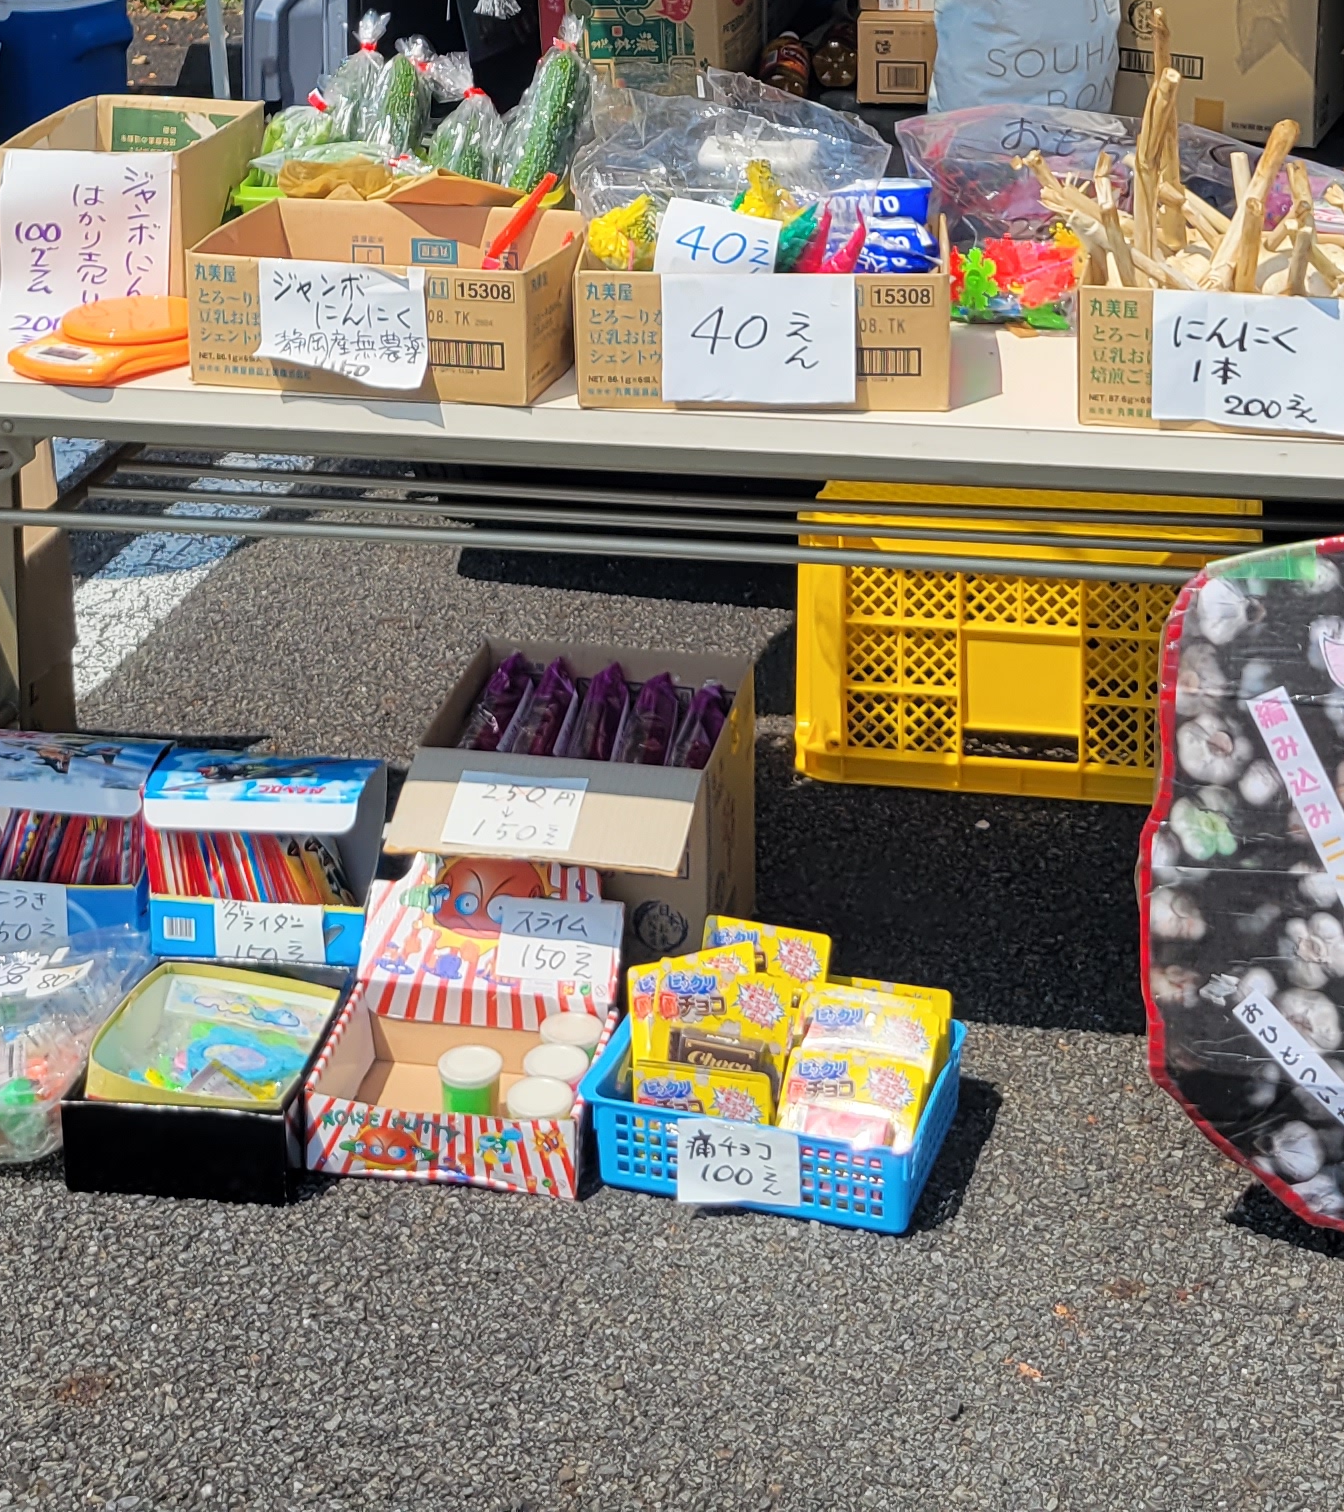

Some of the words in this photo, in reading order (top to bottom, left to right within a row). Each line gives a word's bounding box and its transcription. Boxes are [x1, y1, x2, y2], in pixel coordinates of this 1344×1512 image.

[14, 221, 62, 244] 100
[194, 262, 237, 284] 丸美屋
[197, 288, 260, 307] とろ〜り
[272, 269, 372, 305] ジャンボ
[456, 281, 512, 301] 15308
[585, 282, 634, 301] 丸美屋
[872, 287, 932, 305] 15308
[314, 302, 412, 330] にんにく
[1089, 297, 1138, 320] 丸美屋
[1172, 315, 1300, 354] にんにく
[1191, 356, 1242, 386] 1本
[512, 909, 589, 937] スライム
[666, 974, 718, 993] ビックリ
[814, 1007, 864, 1026] ビックリ
[796, 1060, 848, 1080] ビックリ
[642, 1079, 692, 1099] ビックリ
[685, 1128, 773, 1160] 痛チョコ
